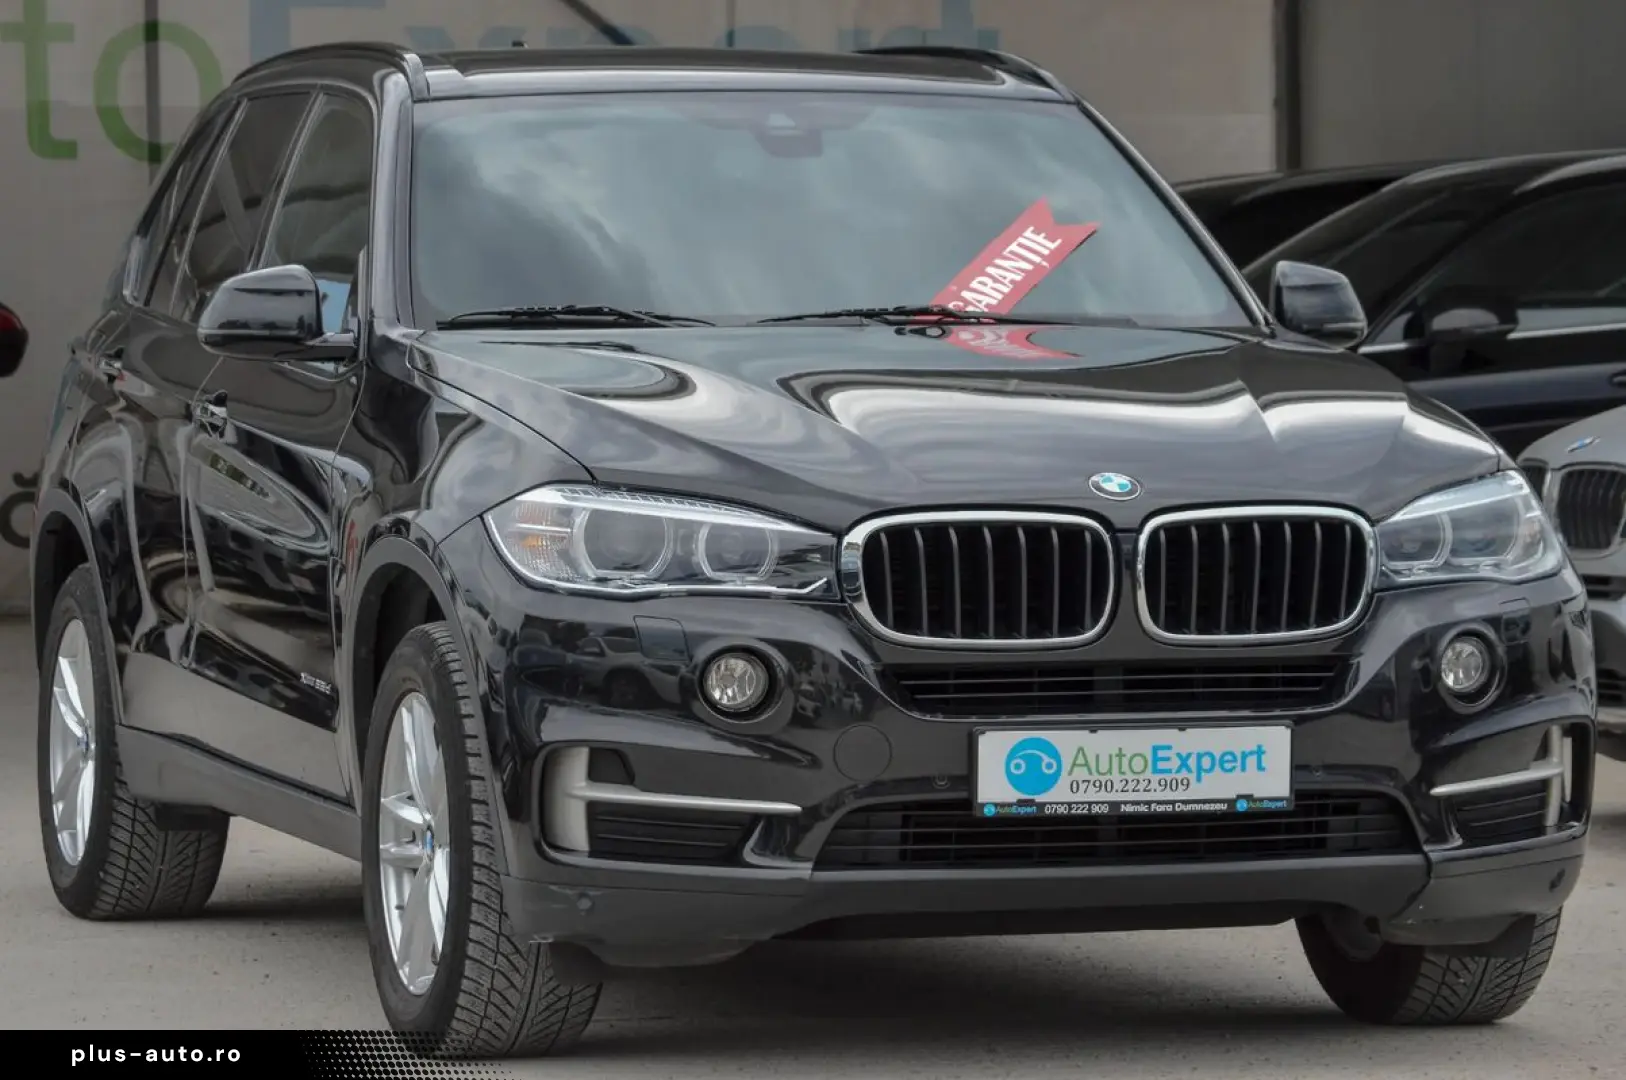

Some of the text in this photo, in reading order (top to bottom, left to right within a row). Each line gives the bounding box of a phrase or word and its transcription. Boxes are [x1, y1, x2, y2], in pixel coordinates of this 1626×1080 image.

[1067, 744, 1266, 783] AutoExpert
[1069, 776, 1191, 794] 0790.222.909
[996, 804, 1038, 814] AutoExpert
[1044, 804, 1069, 814] 0790
[1071, 804, 1089, 813] 222
[1091, 803, 1109, 813] 909
[1120, 804, 1149, 812] Nimic
[1151, 803, 1173, 812] Fara
[1249, 799, 1287, 809] AutoExpert
